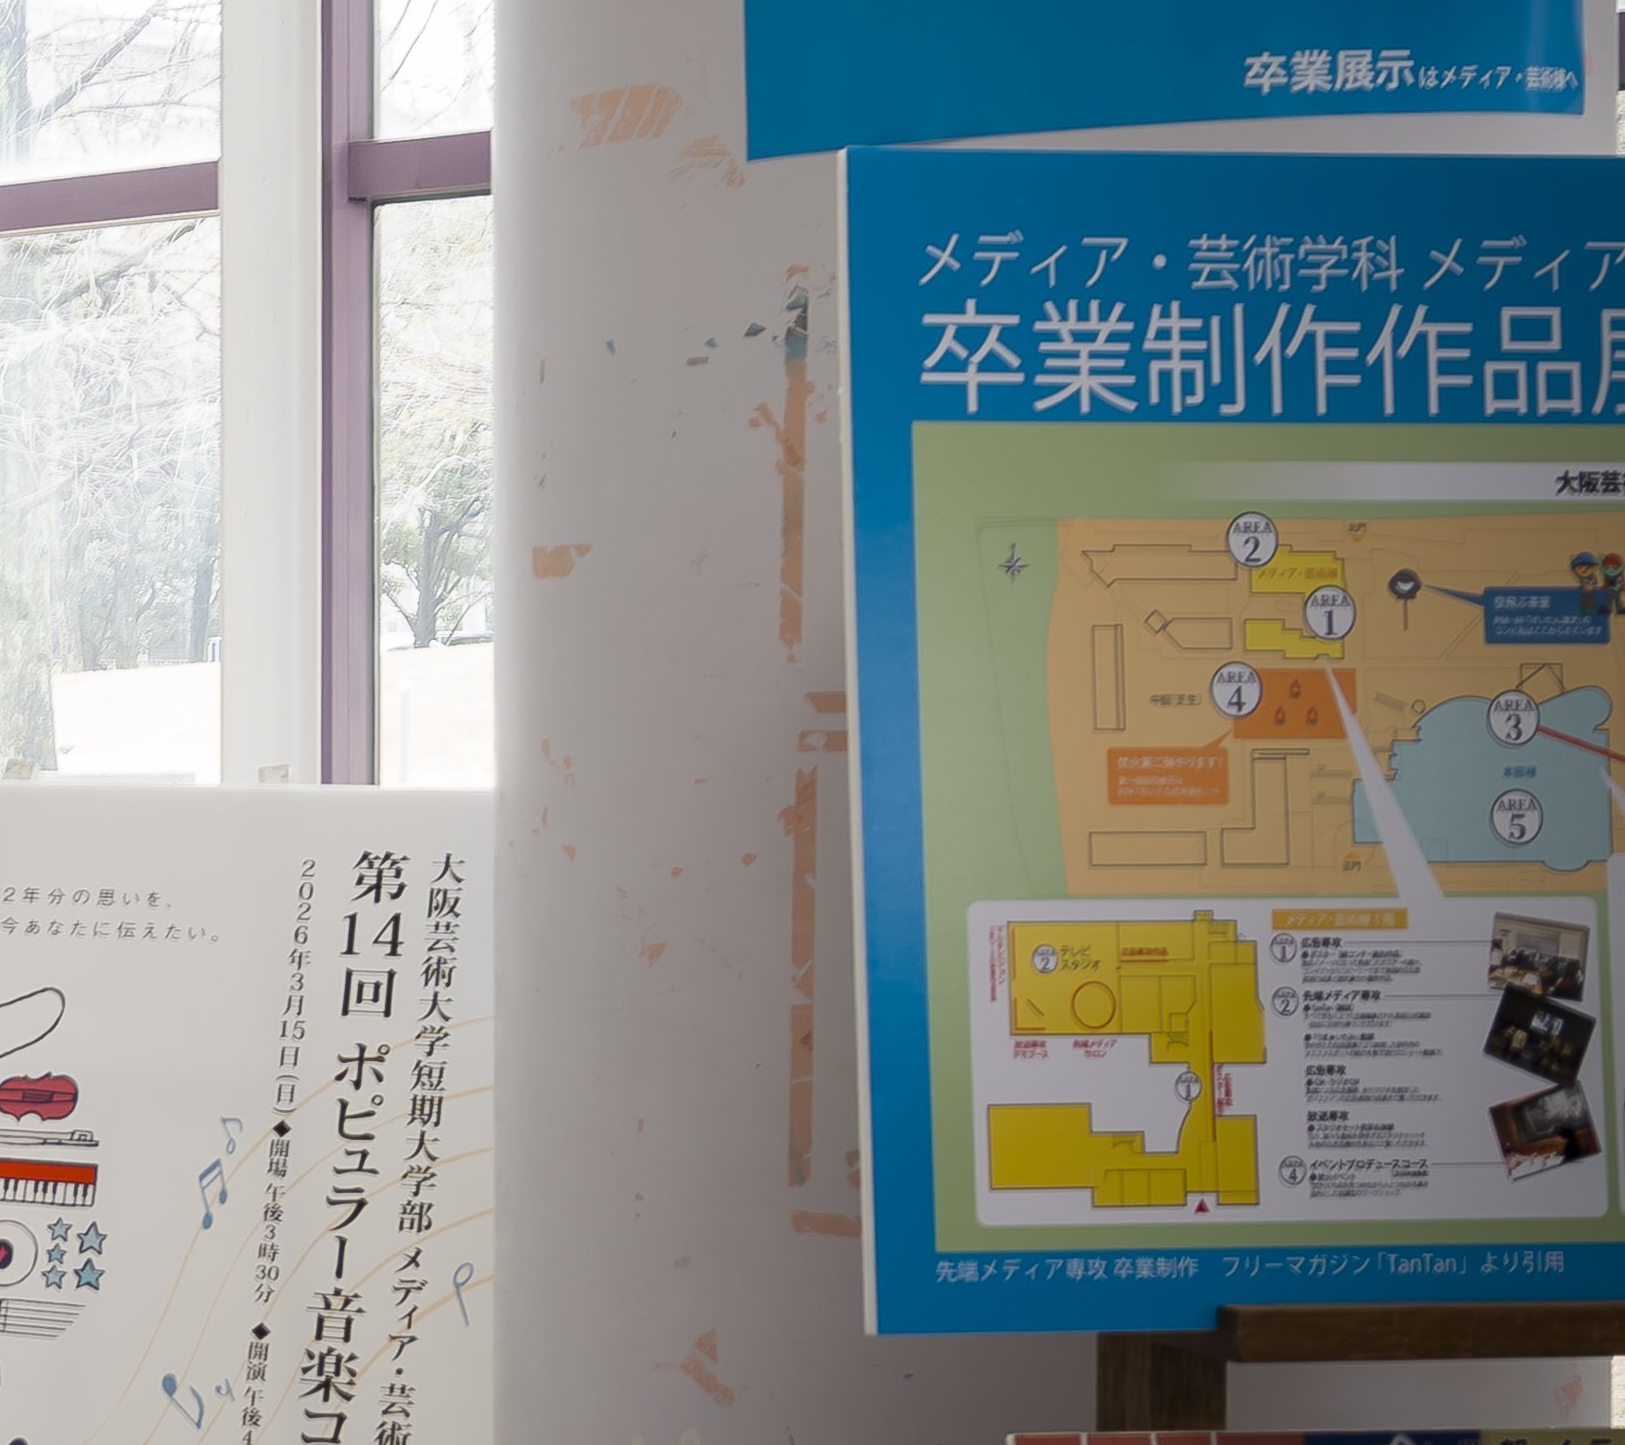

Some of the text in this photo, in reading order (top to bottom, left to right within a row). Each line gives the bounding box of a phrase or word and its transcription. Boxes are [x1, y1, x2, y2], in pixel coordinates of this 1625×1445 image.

[919, 229, 1405, 294] メディア・芸術学科
[1555, 469, 1625, 497] 大阪芸
[1243, 536, 1262, 564] 2
[1324, 610, 1337, 637] 1
[1225, 684, 1247, 713] 4
[1505, 713, 1522, 742] 3
[1509, 812, 1527, 842] 5
[1, 886, 173, 910] 2年分の思いを、
[0, 916, 221, 945] 今あなたに伝えたい。
[338, 849, 413, 1020] 第14回
[1040, 957, 1051, 972] 2
[1280, 945, 1287, 961] 1
[272, 858, 316, 1115] 2026年3月15日(日)
[1281, 998, 1290, 1013] 2
[397, 851, 467, 1235] 大阪芸術大学短期大学部
[1184, 1084, 1192, 1100] 1
[1288, 1168, 1298, 1182] 4
[935, 1259, 1108, 1283] 先端メディア専攻
[1113, 1257, 1200, 1280] 卒業制作
